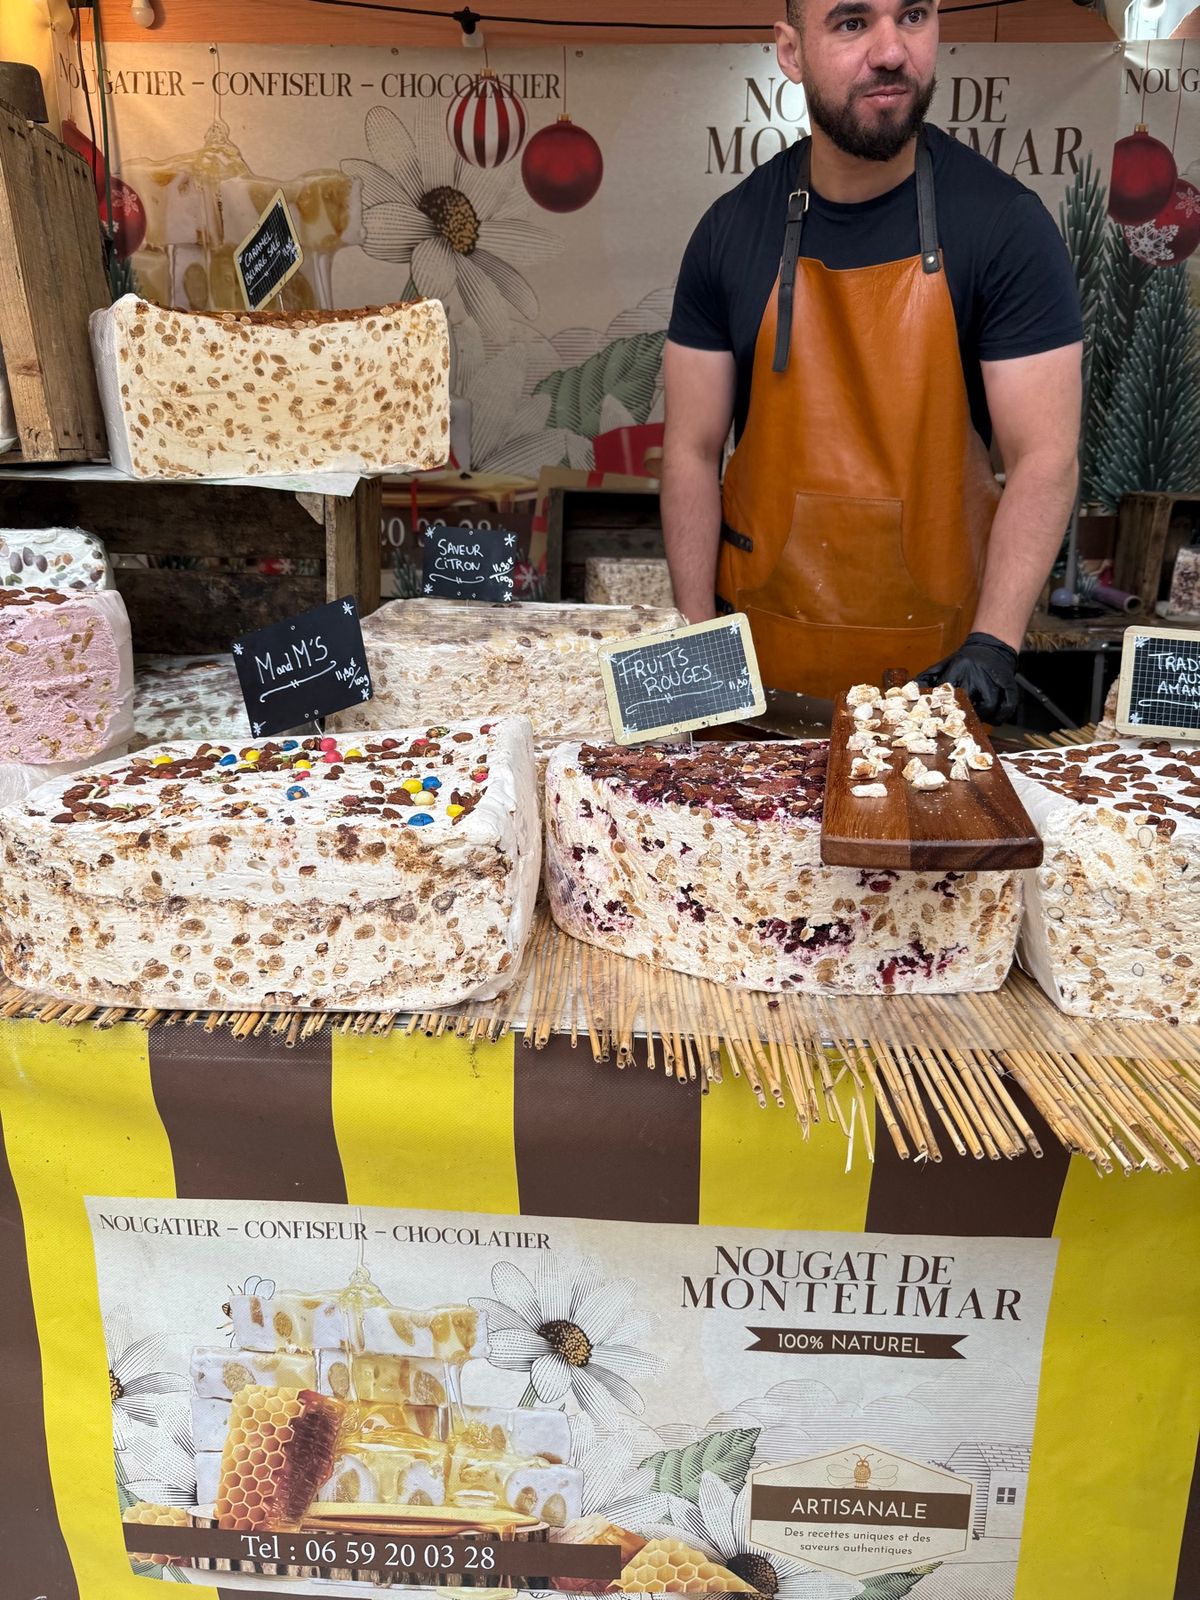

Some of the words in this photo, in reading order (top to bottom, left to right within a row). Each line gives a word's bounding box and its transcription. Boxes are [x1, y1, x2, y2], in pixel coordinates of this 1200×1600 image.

[212, 72, 352, 98] CONFISEUR
[948, 76, 1010, 123] DE
[437, 538, 484, 558] SAVEUR
[642, 664, 712, 697] ROUGES
[99, 1213, 220, 1237] NOUGATIER
[244, 1219, 368, 1241] CONFISEUR
[392, 1225, 552, 1250] CHOCOLATIER
[714, 1245, 887, 1282] NOUGAT
[900, 1253, 955, 1285] DE
[681, 1276, 1022, 1321] MONTELIMAR
[777, 1333, 824, 1350] 100%
[831, 1335, 926, 1354] NATUREL
[790, 1498, 927, 1520] ARTISANALE
[784, 1526, 804, 1538] Des
[807, 1528, 850, 1540] recettes
[853, 1532, 894, 1544] uniques
[898, 1532, 908, 1543] et
[911, 1532, 931, 1543] des
[799, 1543, 840, 1552] saveurs
[843, 1541, 913, 1556] authentiques
[240, 1534, 281, 1560] Tel
[304, 1540, 338, 1563] 06
[345, 1542, 377, 1566] 59
[384, 1544, 417, 1567] 20
[423, 1546, 456, 1569] 03
[463, 1547, 497, 1570] 28
